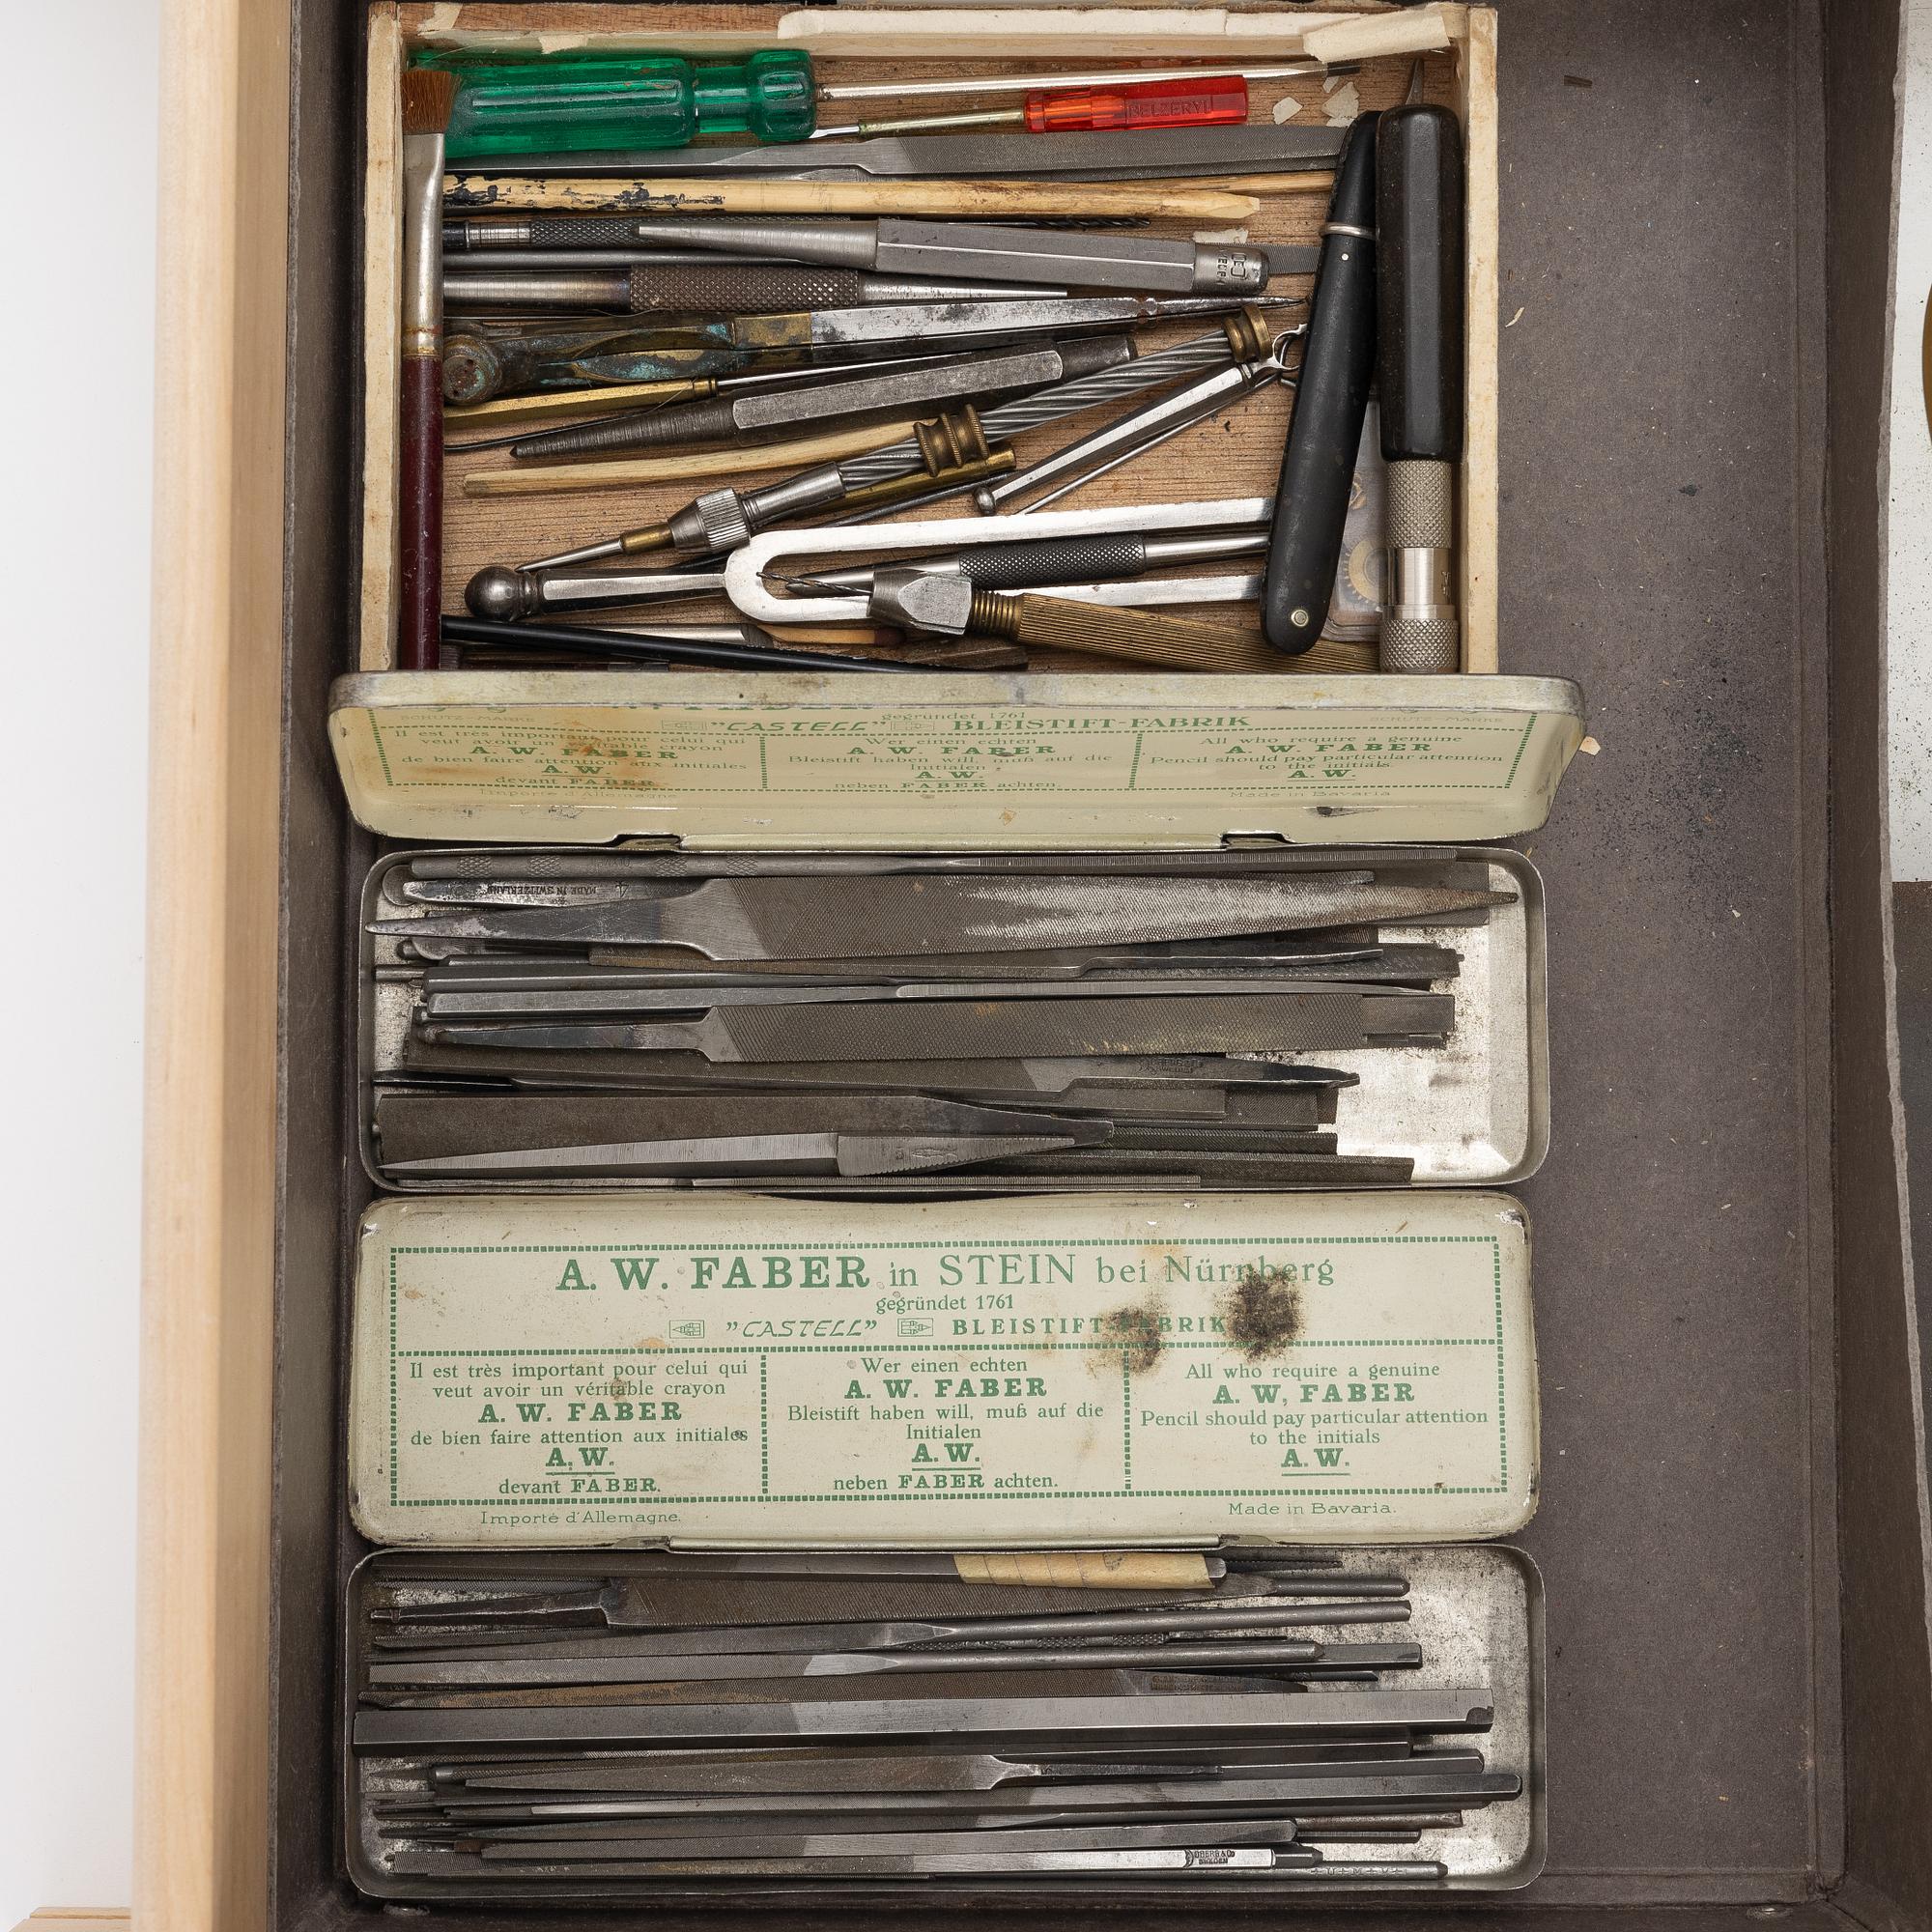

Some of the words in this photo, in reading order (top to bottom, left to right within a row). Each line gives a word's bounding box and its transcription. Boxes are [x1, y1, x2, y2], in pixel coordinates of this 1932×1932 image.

[952, 717, 1251, 730] BLEISTIFT-FABRIK
[1290, 735, 1357, 744] require
[469, 746, 497, 754] A.
[508, 747, 545, 755] W.
[561, 748, 678, 759] FABER
[941, 746, 1056, 755] FABER
[1224, 745, 1253, 753] A.
[1315, 744, 1432, 753] FABER
[674, 761, 747, 770] initiales
[1215, 754, 1278, 763] should
[542, 764, 568, 774] A.
[575, 765, 611, 775] W.
[949, 771, 983, 780] W.
[1288, 770, 1316, 779] A.
[1321, 769, 1355, 778] W.
[487, 885, 554, 895] SWITZERLAND
[556, 886, 567, 895] IN
[571, 886, 597, 895] MADE
[555, 1259, 597, 1291] A.
[611, 1258, 668, 1291] W.
[691, 1256, 870, 1290] FABER
[890, 1262, 919, 1287] in
[939, 1253, 1076, 1286] STEIN
[1097, 1256, 1148, 1284] bei
[1164, 1255, 1334, 1286] Nürnberg
[875, 1293, 966, 1315] gegründet
[976, 1293, 1013, 1310] 1761
[410, 1362, 423, 1378] Il
[433, 1364, 459, 1378] est
[469, 1363, 502, 1378] très
[512, 1362, 605, 1382] important
[613, 1363, 658, 1379] pour
[667, 1360, 709, 1376] celui
[719, 1360, 749, 1378] qui
[861, 1357, 901, 1373] Wer
[910, 1358, 959, 1374] einen
[969, 1356, 1028, 1373] echten
[1185, 1363, 1213, 1379] All
[1223, 1363, 1262, 1379] who
[1271, 1362, 1338, 1382] require
[1348, 1366, 1358, 1378] a
[1368, 1363, 1440, 1381] genuine
[433, 1385, 473, 1398] veut
[483, 1382, 531, 1398] avoir
[541, 1386, 563, 1398] un
[574, 1380, 654, 1397] véritable
[664, 1382, 726, 1398] crayon
[843, 1379, 871, 1400] A.
[882, 1379, 919, 1399] W.
[934, 1378, 1047, 1398] FABER
[1213, 1384, 1240, 1405] A.
[1299, 1382, 1415, 1404] FABER
[477, 1404, 506, 1423] A.
[515, 1403, 551, 1423] W.
[566, 1402, 682, 1422] FABER
[787, 1405, 860, 1422] Bleistift
[869, 1405, 925, 1420] haben
[935, 1404, 974, 1422] will,
[986, 1404, 1028, 1420] muß
[1037, 1403, 1067, 1419] auf
[1076, 1402, 1104, 1418] die
[1141, 1410, 1198, 1427] Pencil
[1205, 1408, 1267, 1426] should
[1274, 1413, 1305, 1429] pay
[1311, 1407, 1401, 1429] particular
[1405, 1408, 1489, 1424] attention
[411, 1431, 433, 1445] de
[442, 1430, 481, 1445] bien
[491, 1430, 530, 1445] faire
[540, 1430, 623, 1445] attention
[633, 1430, 665, 1443] aux
[676, 1427, 749, 1442] initiales
[905, 1424, 981, 1440] Initialen
[1250, 1431, 1268, 1446] to
[1278, 1429, 1307, 1445] the
[1317, 1428, 1380, 1444] initials
[545, 1447, 573, 1467] A.
[578, 1447, 614, 1467] W.
[911, 1443, 940, 1463] A.
[943, 1443, 980, 1463] W.
[1281, 1448, 1309, 1468] A.
[1313, 1448, 1350, 1468] W.
[498, 1479, 561, 1495] devant
[570, 1478, 662, 1494] FABER.
[833, 1475, 888, 1492] neben
[897, 1473, 985, 1490] FABER
[993, 1472, 1059, 1489] achten.
[1229, 1503, 1279, 1517] Made
[1286, 1502, 1304, 1516] in
[1311, 1501, 1398, 1516] Bavaria.
[565, 1510, 682, 1526] d'Allemagne.
